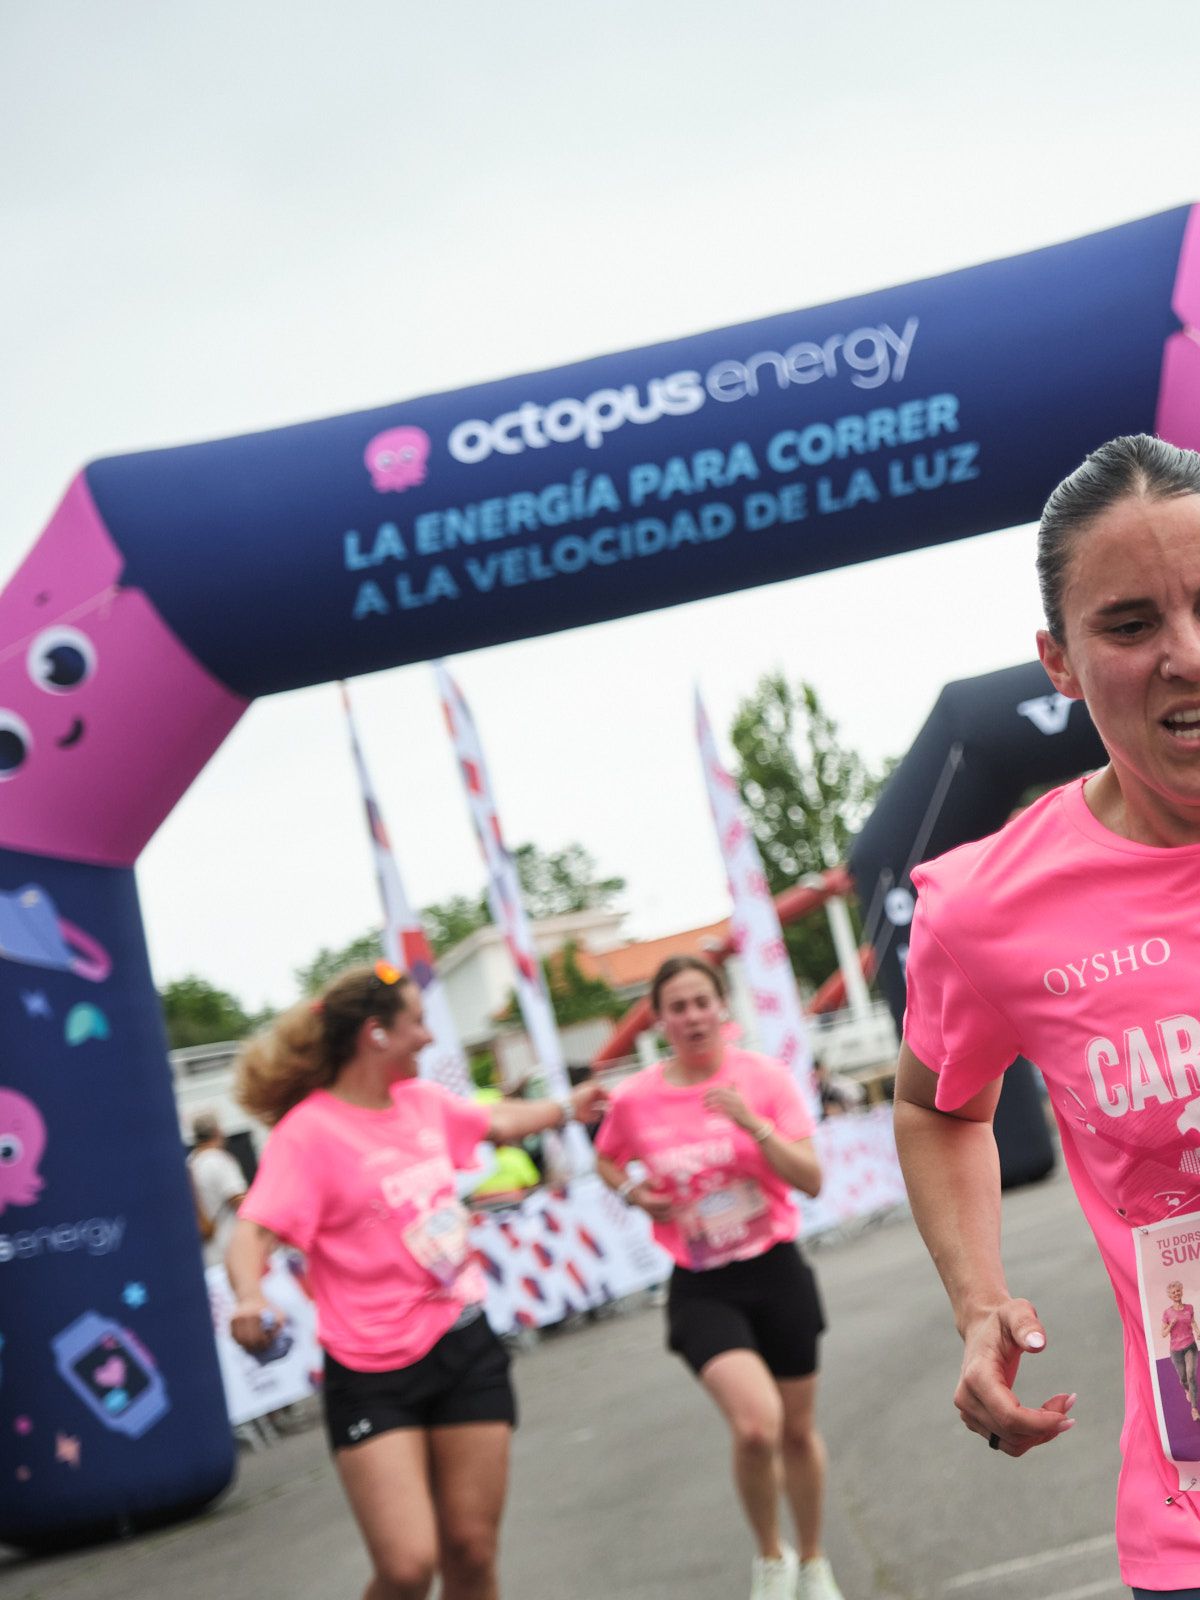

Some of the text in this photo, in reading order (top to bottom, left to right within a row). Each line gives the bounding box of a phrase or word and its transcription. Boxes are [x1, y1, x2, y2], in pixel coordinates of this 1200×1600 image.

[344, 394, 959, 571] LA ENERGÍA PARA CORRER
[352, 442, 979, 620] A LA VELOCIDAD DE LA LUZ
[1043, 937, 1171, 996] OYSHO
[1156, 1237, 1174, 1250] TU
